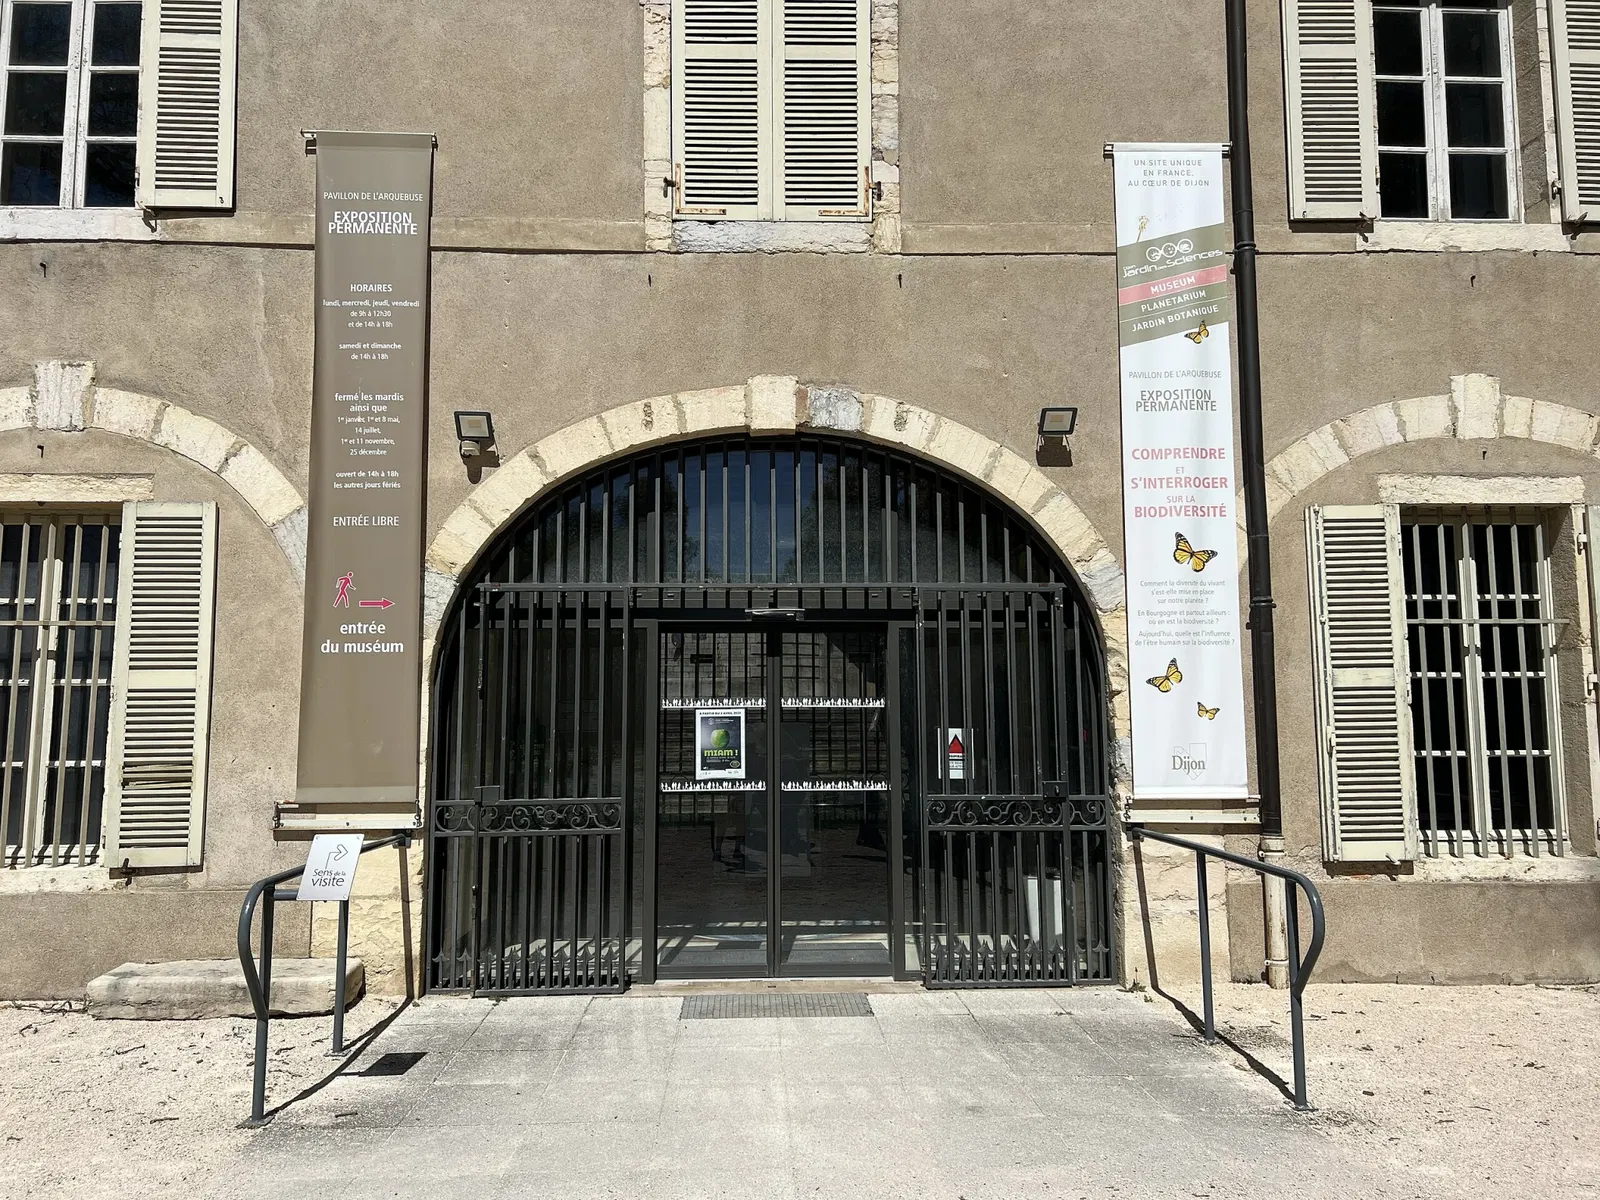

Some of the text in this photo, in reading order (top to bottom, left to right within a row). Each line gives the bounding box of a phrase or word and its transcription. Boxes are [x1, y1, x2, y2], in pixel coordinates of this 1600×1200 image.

[373, 192, 423, 202] L'ARQUEBUSE
[334, 211, 412, 223] EXPOSITION
[329, 222, 418, 235] PERMANENTE
[350, 284, 393, 292] HORAIRES
[1150, 276, 1196, 294] MUSEUM
[1141, 290, 1206, 312] PLANETARIUM
[1132, 305, 1219, 332] JARDIN BOTANIQUE
[1176, 370, 1221, 378] L'ARQUEBUSE
[335, 393, 404, 401] fermé les mardis
[1140, 389, 1211, 401] EXPOSITION
[350, 403, 369, 412] ainsi
[1136, 400, 1217, 412] PERMANENTE
[1132, 448, 1226, 460] COMPRENDRE
[1131, 477, 1228, 489] S'INTERROGER
[1134, 503, 1227, 518] BIODIVERSITÉ
[333, 514, 399, 526] ENTRÉE LIBRE
[340, 621, 386, 634] entrée
[321, 640, 404, 653] du muséum
[1172, 755, 1206, 775] Dijon
[313, 868, 333, 877] Sens
[312, 876, 344, 887] visite
